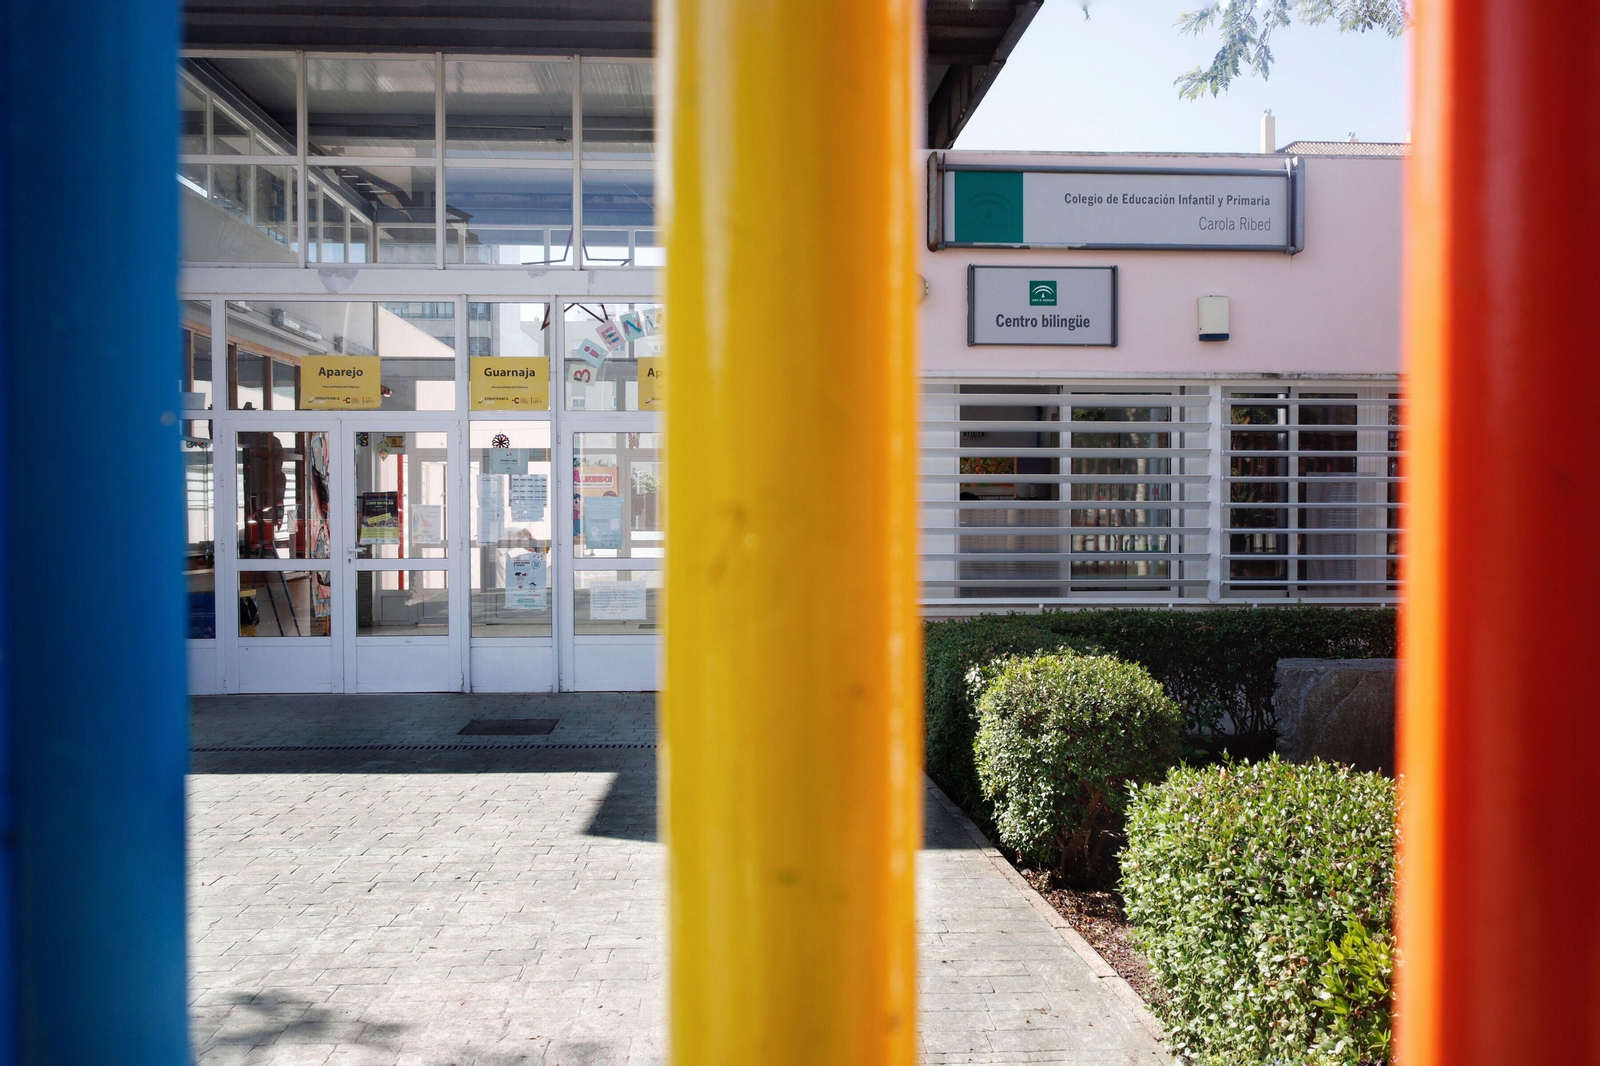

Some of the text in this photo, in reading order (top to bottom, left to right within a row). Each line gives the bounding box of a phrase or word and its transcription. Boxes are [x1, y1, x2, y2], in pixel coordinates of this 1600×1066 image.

[1064, 193, 1270, 207] Colegio de Educación Infantil y Primaria
[1198, 216, 1271, 231] Carola Ribed
[995, 313, 1090, 331] Centro bilingüe
[318, 366, 364, 379] Aparejo
[483, 367, 536, 380] Guarnaja
